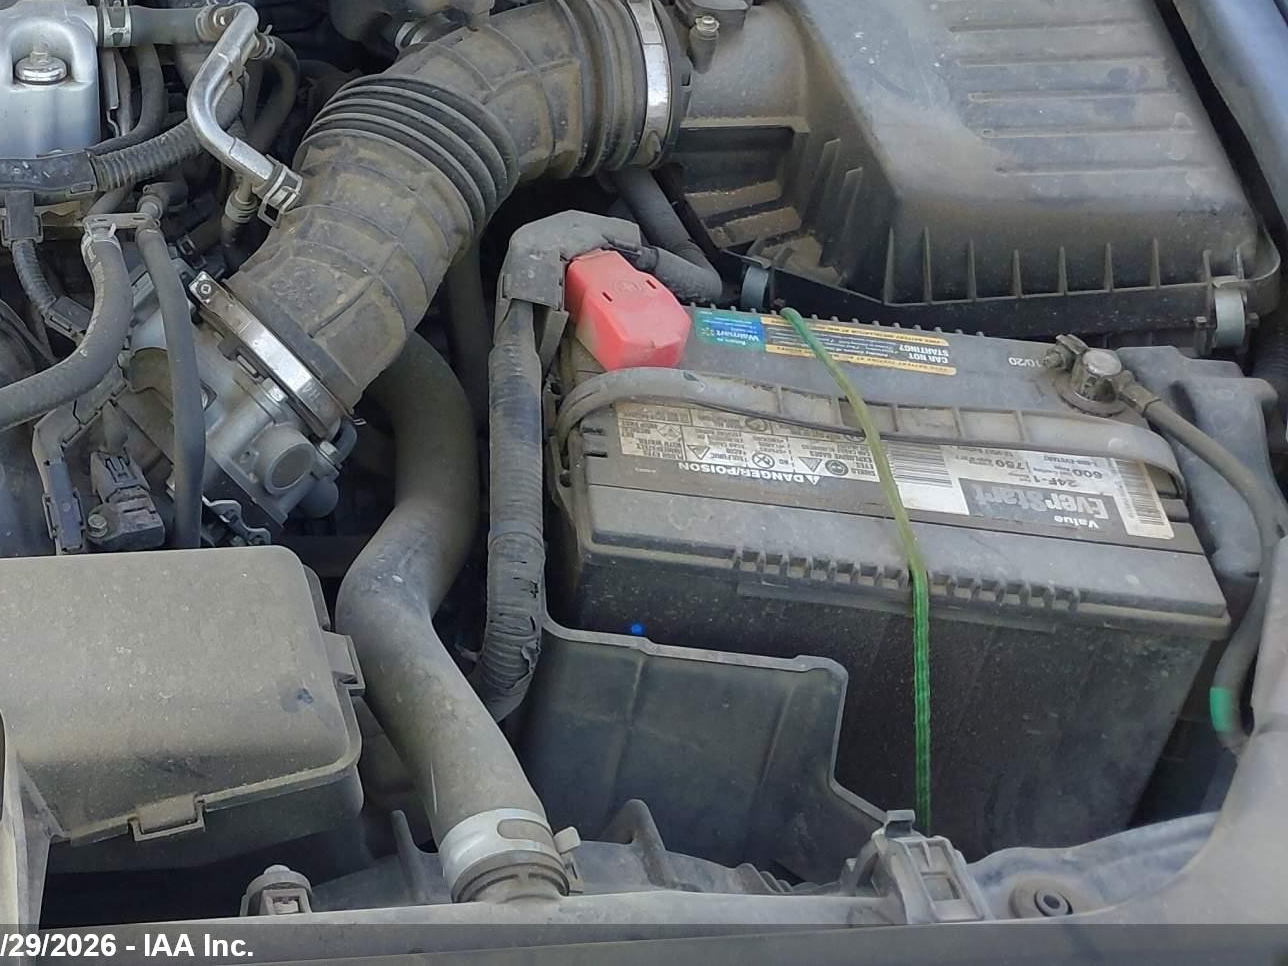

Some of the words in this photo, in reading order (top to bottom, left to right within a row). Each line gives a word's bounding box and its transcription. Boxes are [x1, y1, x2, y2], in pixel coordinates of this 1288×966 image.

[716, 330, 759, 342] Walmart
[899, 344, 949, 357] STARTING?
[928, 355, 948, 364] CAR
[678, 462, 805, 482] DANGER/POISON
[1072, 468, 1103, 479] 600
[1033, 475, 1078, 488] 24F-1
[974, 485, 1108, 519] EverStart
[1054, 516, 1099, 528] Value
